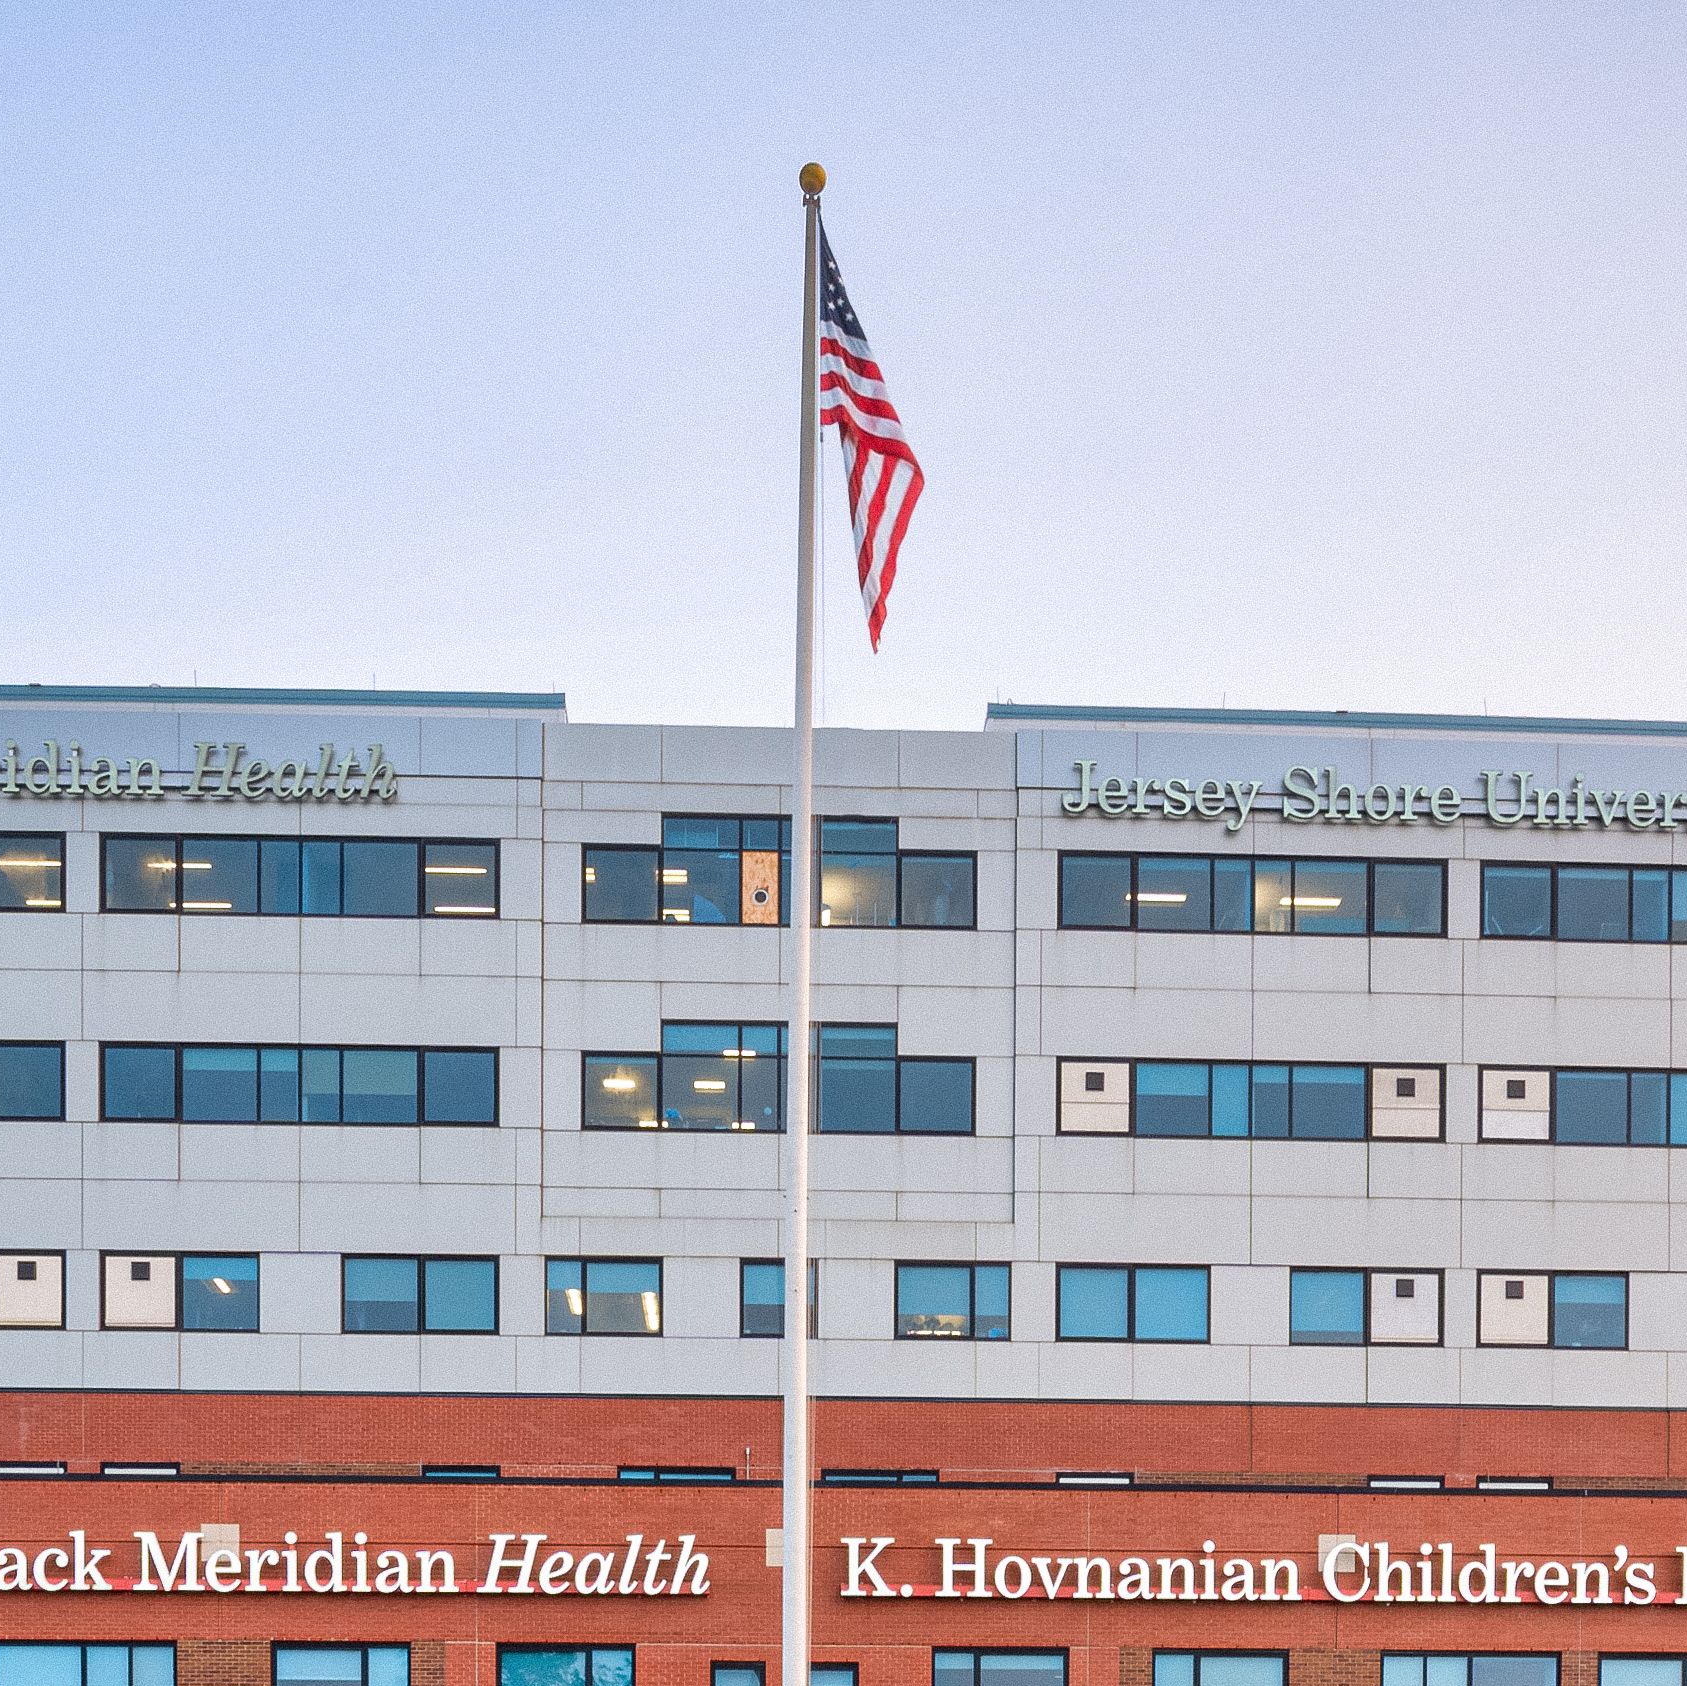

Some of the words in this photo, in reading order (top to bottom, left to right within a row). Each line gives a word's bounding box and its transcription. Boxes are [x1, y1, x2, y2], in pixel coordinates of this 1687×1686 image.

[184, 741, 398, 801] Health
[1063, 761, 1262, 829] Jersey
[1283, 766, 1462, 826] Shore
[134, 1529, 458, 1594] Meridian
[477, 1532, 711, 1597] Health
[841, 1536, 915, 1598] K.
[934, 1537, 1303, 1602] Hovnanian
[1323, 1540, 1656, 1607] Children's
